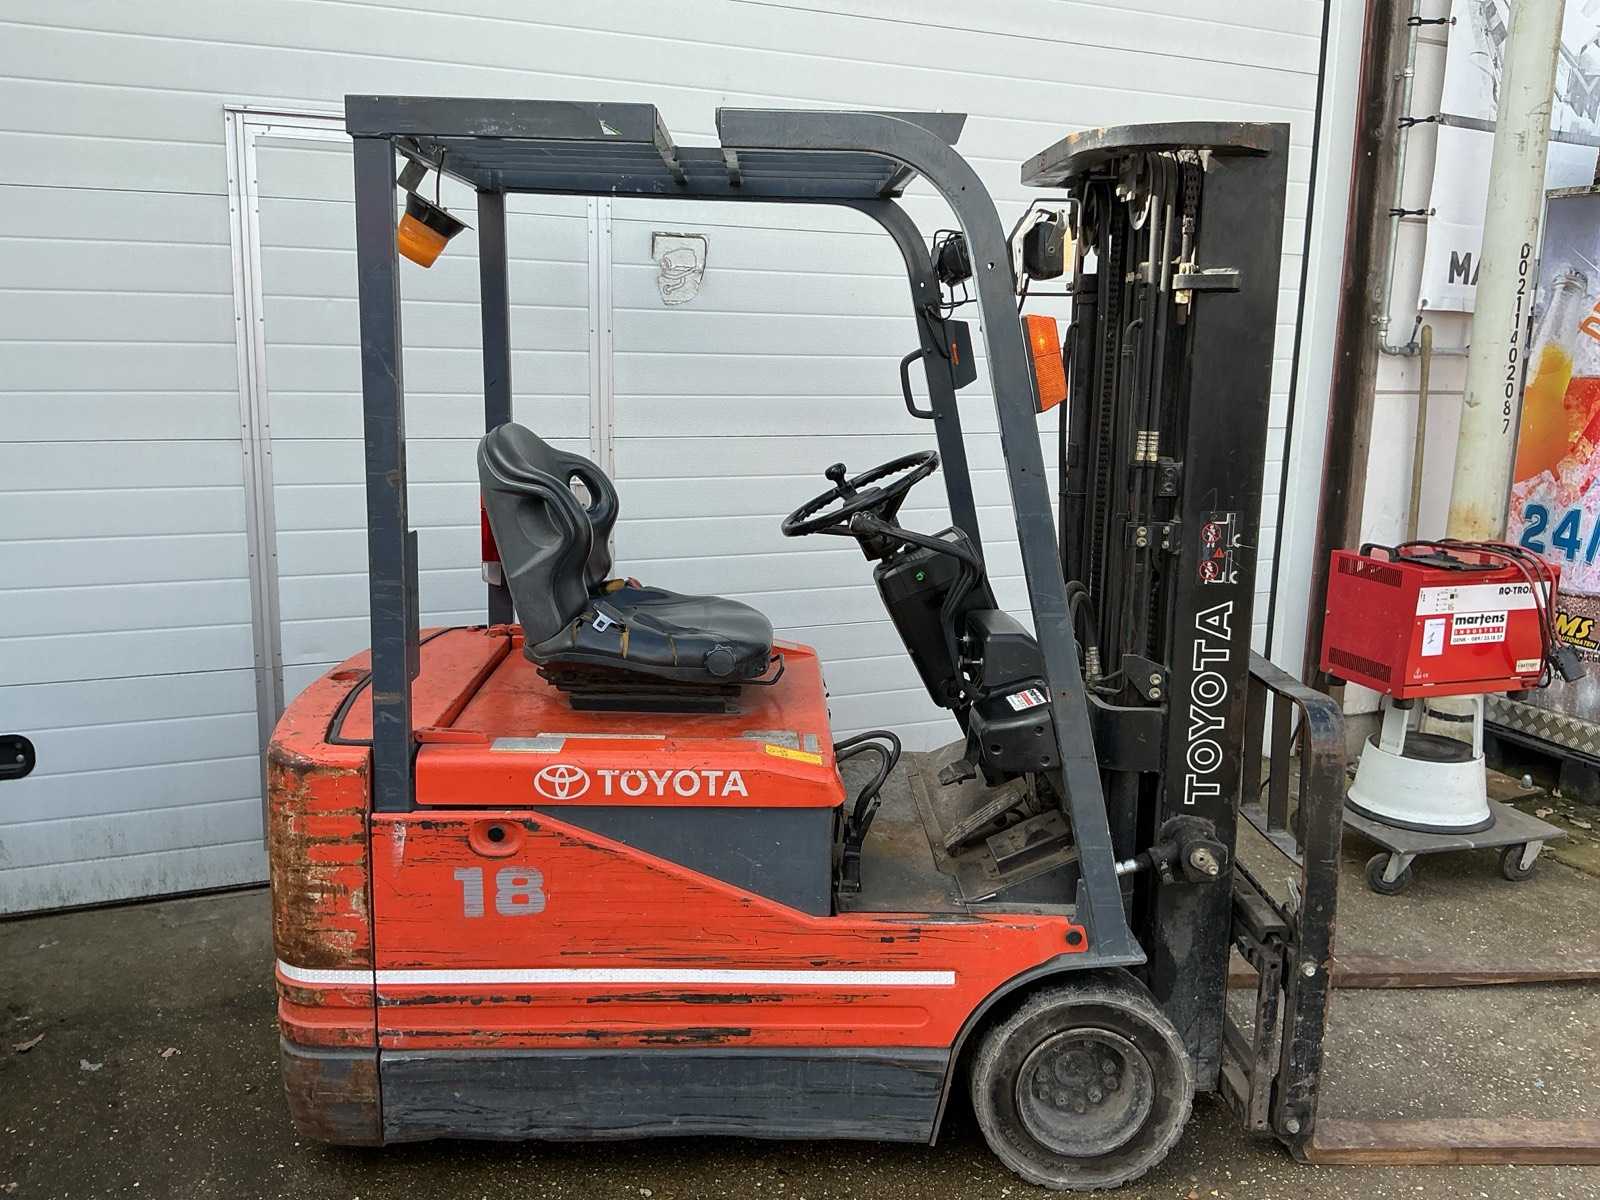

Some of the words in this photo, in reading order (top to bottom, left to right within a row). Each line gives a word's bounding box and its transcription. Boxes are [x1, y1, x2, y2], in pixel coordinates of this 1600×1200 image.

[1455, 614, 1505, 626] martens
[1560, 635, 1597, 648] UTOMATEN
[1184, 600, 1234, 805] TOYOTA
[597, 770, 749, 797] TOYOTA
[454, 866, 546, 919] 18
